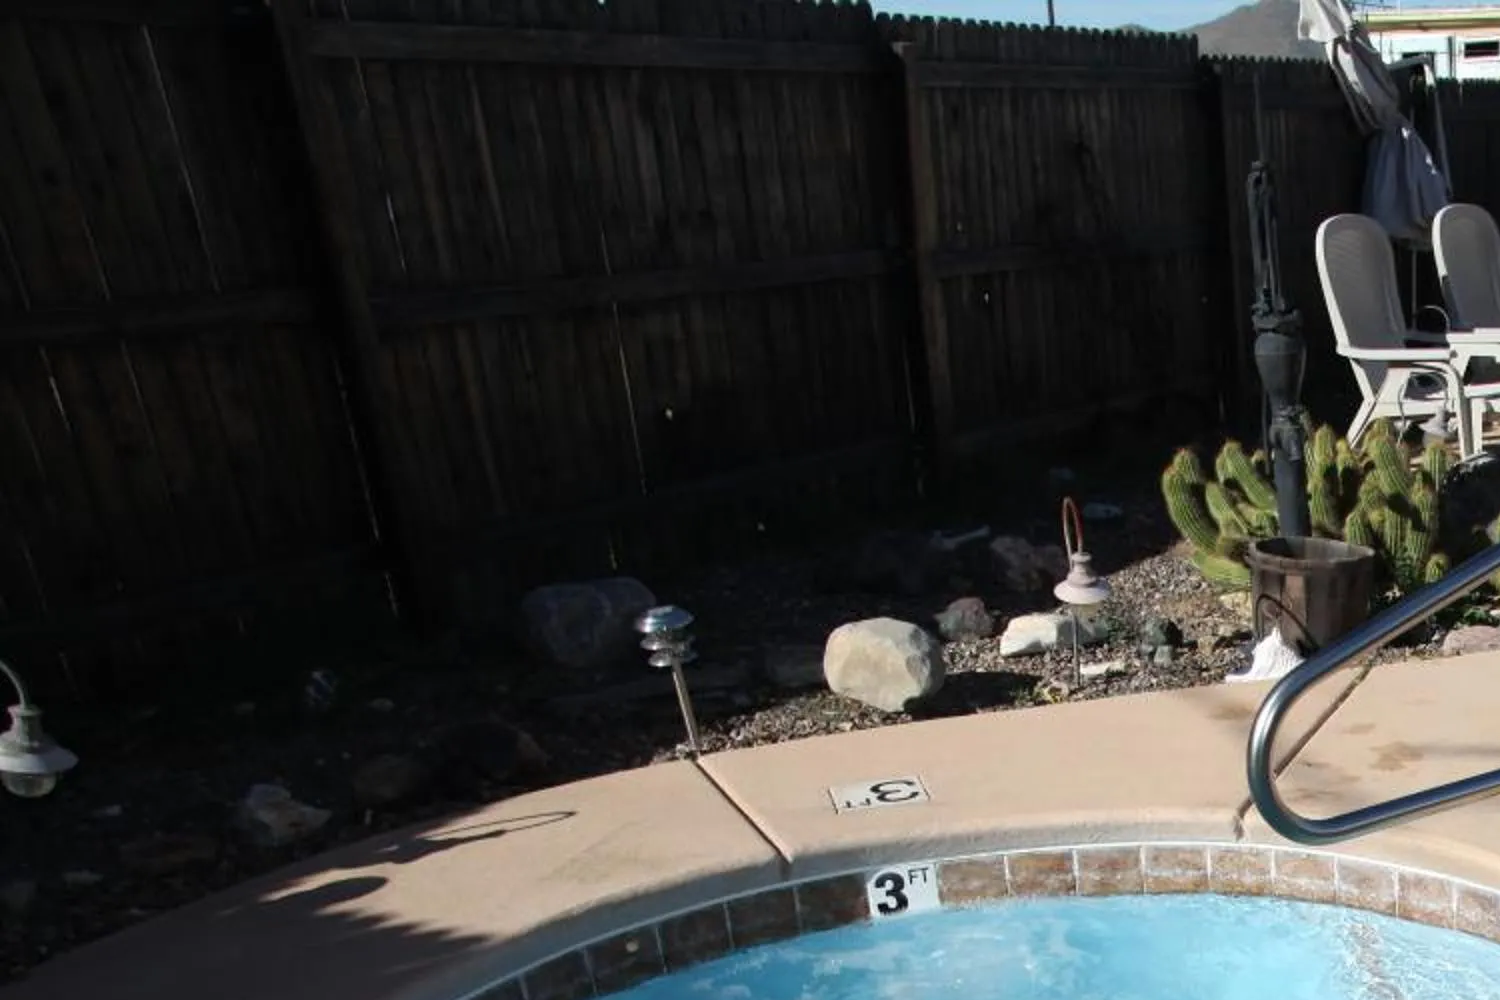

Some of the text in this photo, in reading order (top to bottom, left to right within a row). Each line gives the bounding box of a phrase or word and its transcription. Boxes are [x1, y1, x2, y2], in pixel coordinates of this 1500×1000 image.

[870, 780, 919, 802] 3
[875, 867, 929, 915] 3 FT
